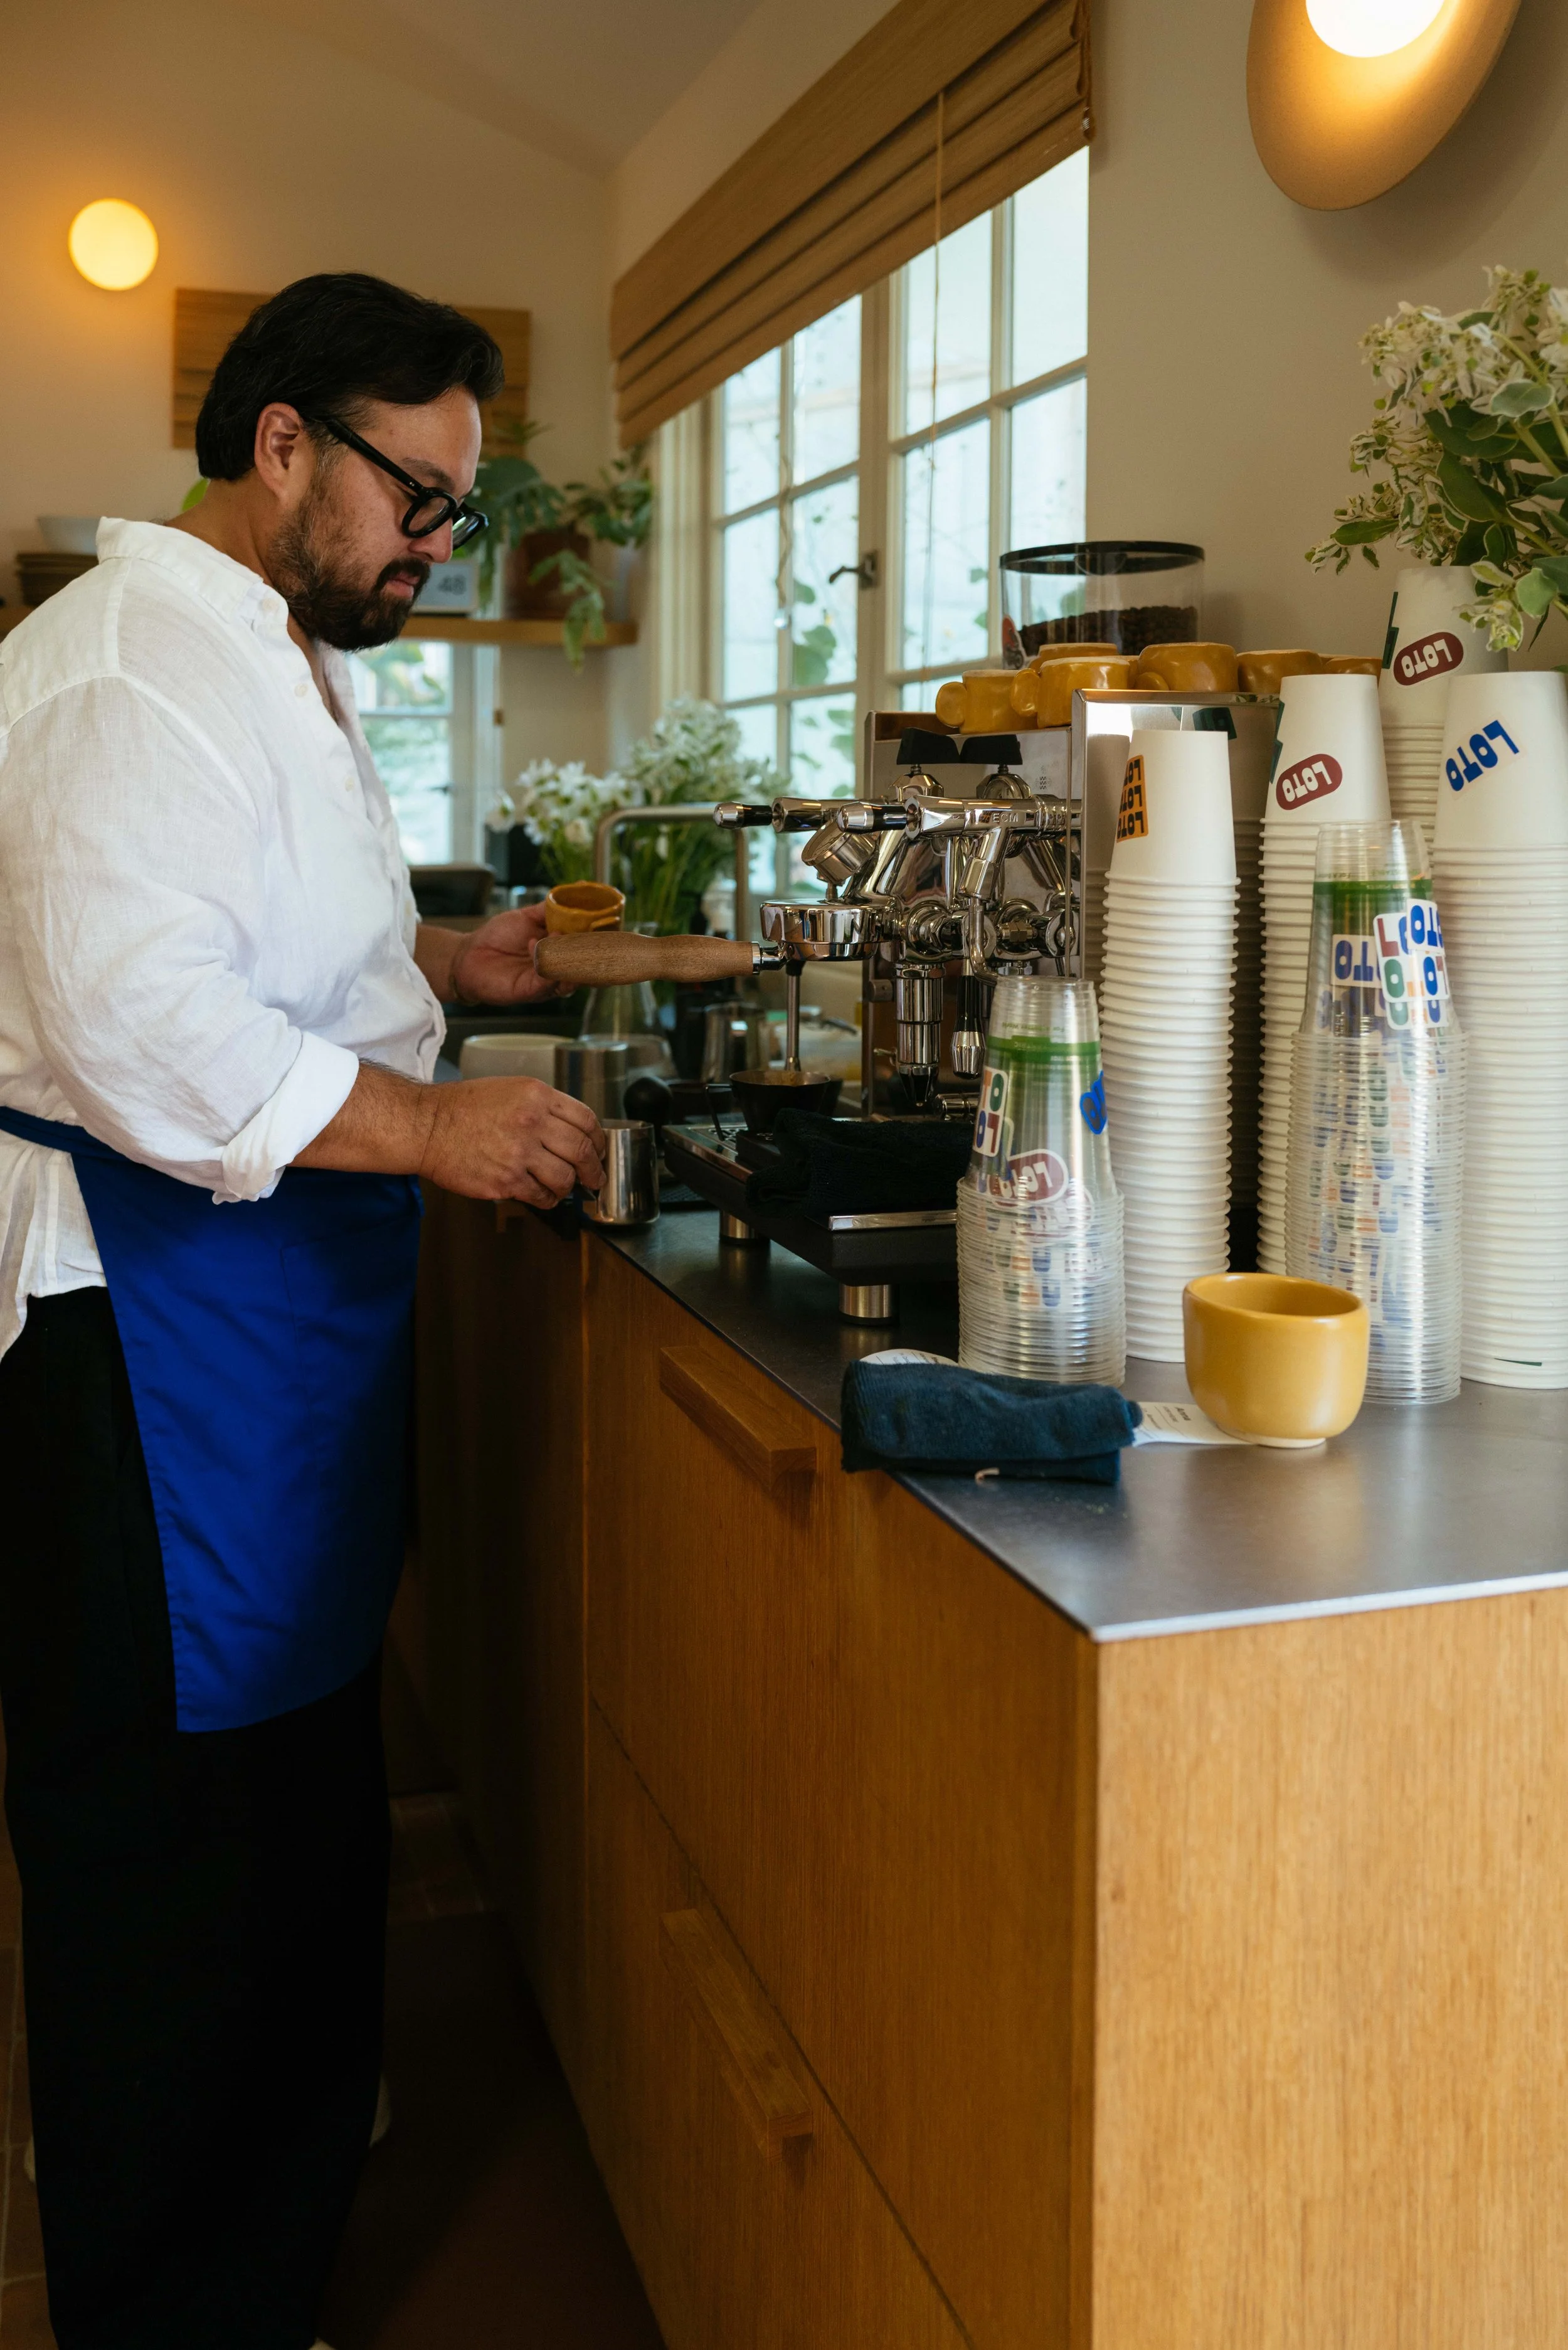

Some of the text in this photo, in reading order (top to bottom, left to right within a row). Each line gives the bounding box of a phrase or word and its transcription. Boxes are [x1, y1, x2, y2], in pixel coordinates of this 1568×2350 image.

[1401, 639, 1453, 678] LOTO
[1446, 720, 1520, 792] LOTO
[1281, 760, 1332, 802] LOTO
[992, 812, 1019, 823] ECM
[1335, 940, 1382, 982] TO
